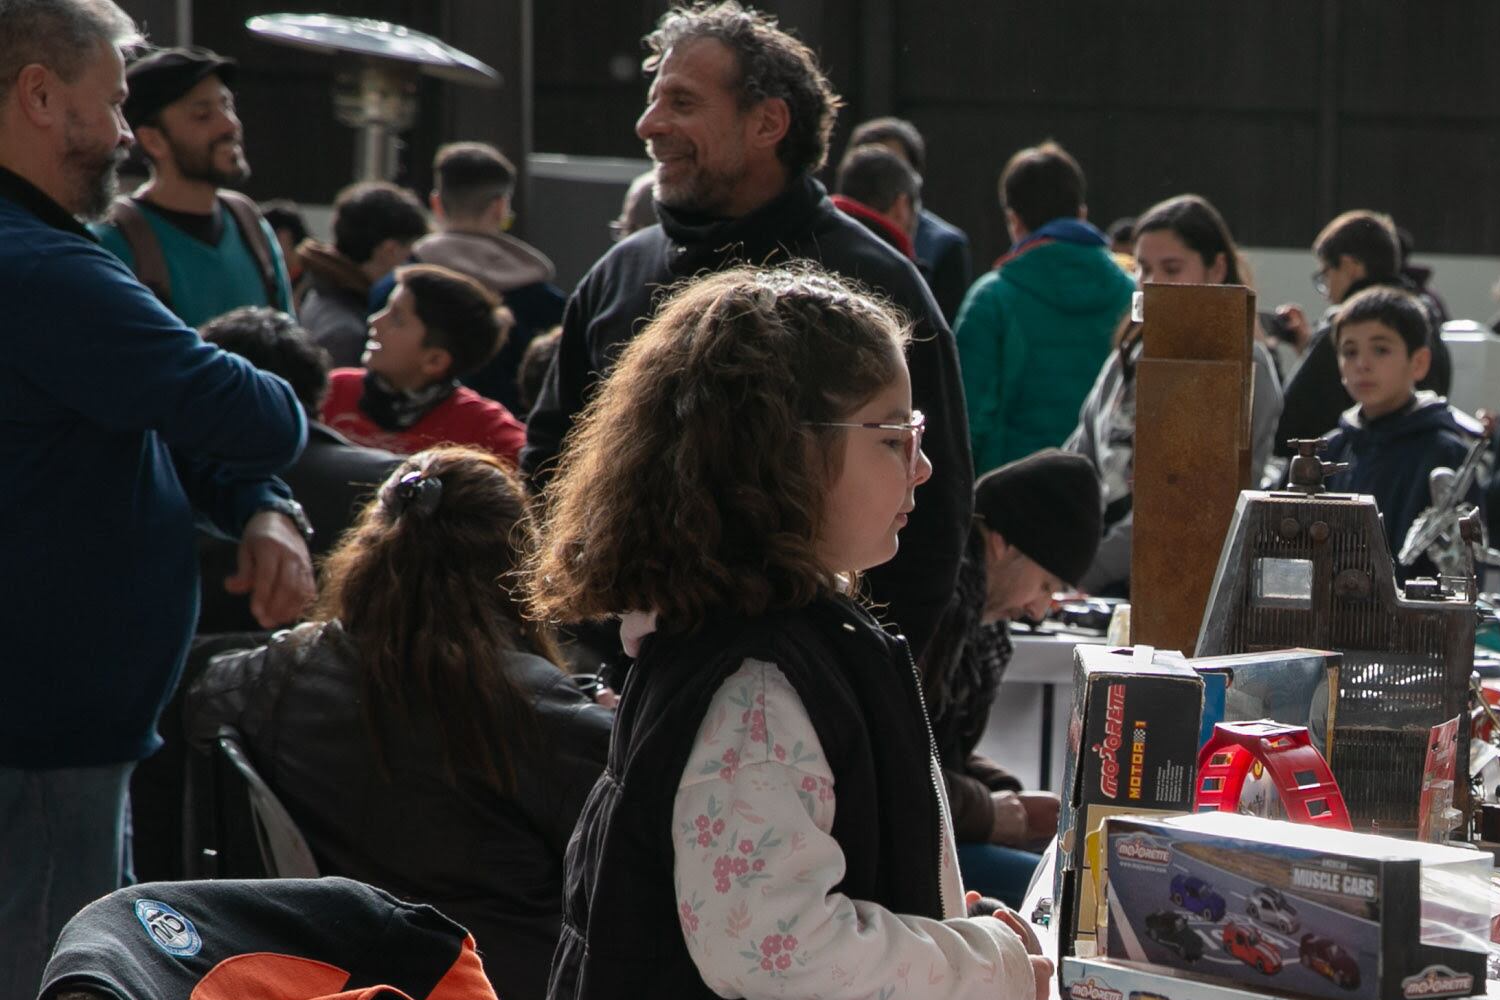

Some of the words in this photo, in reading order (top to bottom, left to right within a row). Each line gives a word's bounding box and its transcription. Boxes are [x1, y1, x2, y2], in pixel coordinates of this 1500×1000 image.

[1129, 742, 1146, 800] MOTOR
[1293, 866, 1340, 892] MUSCLE
[1342, 875, 1375, 898] CARS
